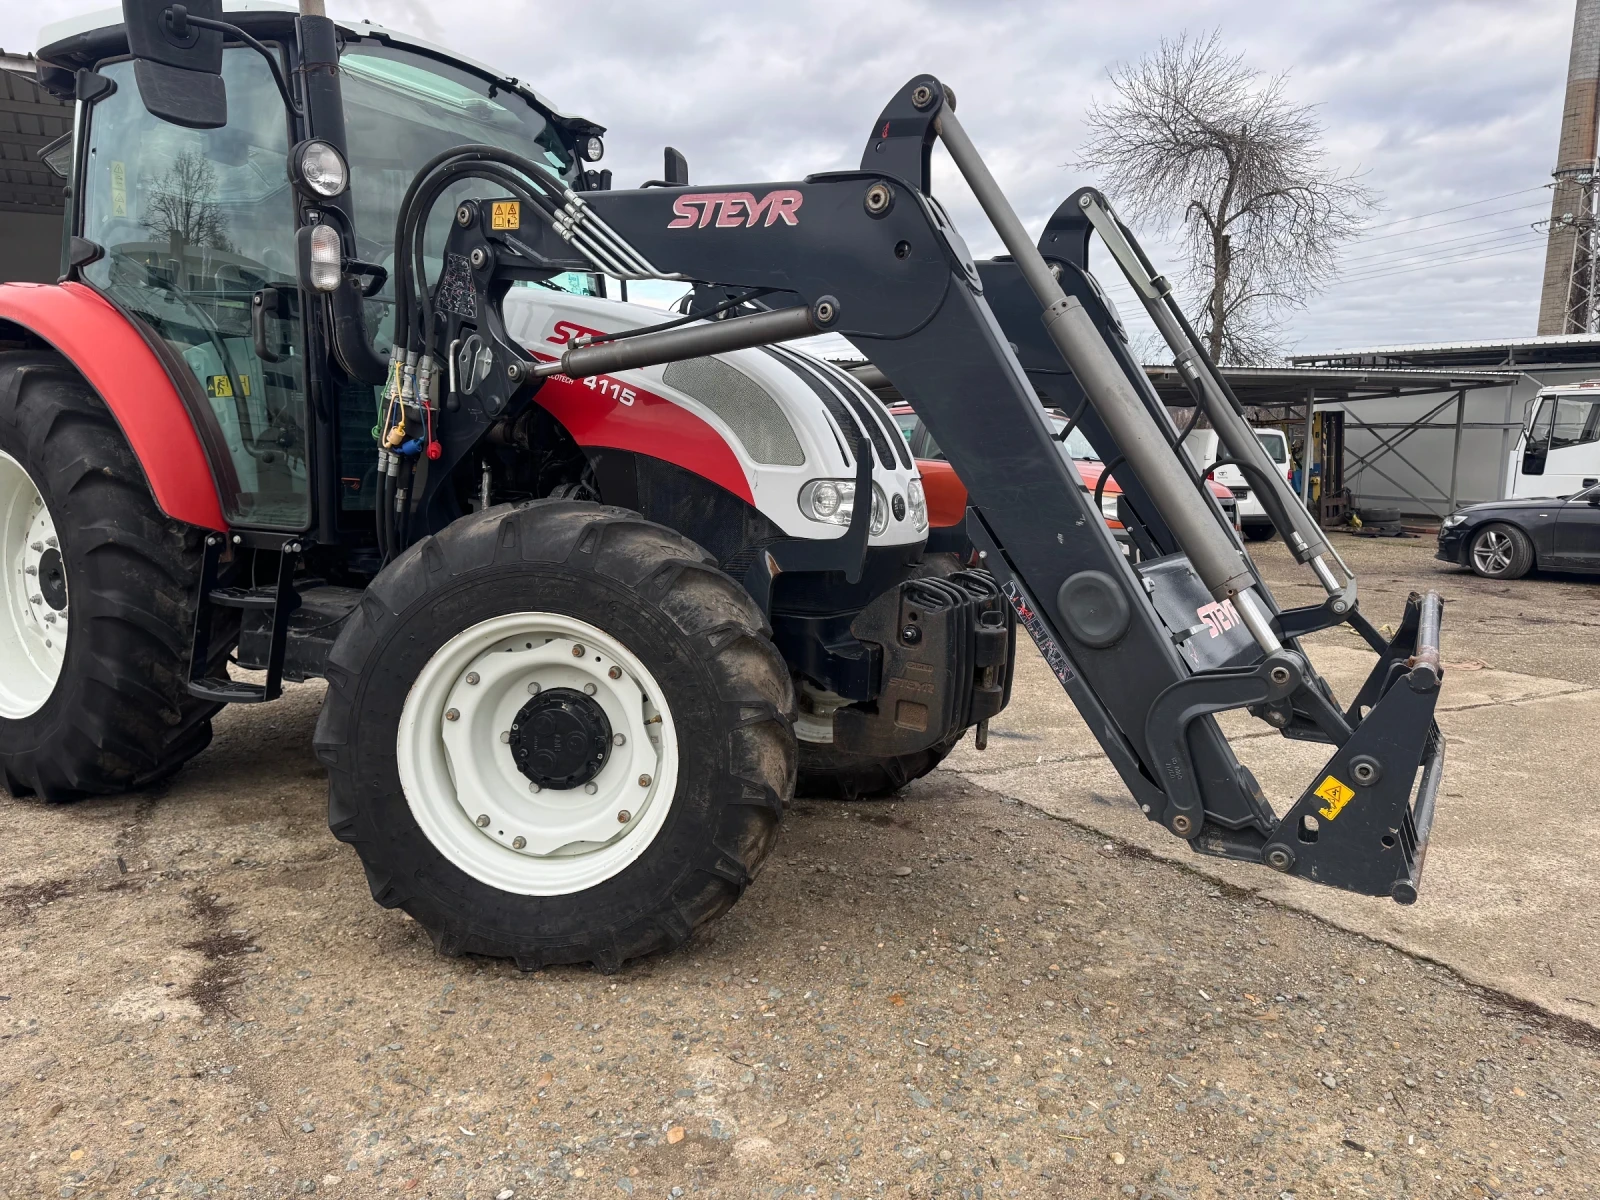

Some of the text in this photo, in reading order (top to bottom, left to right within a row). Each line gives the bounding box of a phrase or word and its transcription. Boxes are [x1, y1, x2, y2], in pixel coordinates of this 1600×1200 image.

[667, 190, 803, 228] STEYR
[547, 373, 574, 385] COTECH
[583, 375, 637, 407] 4115
